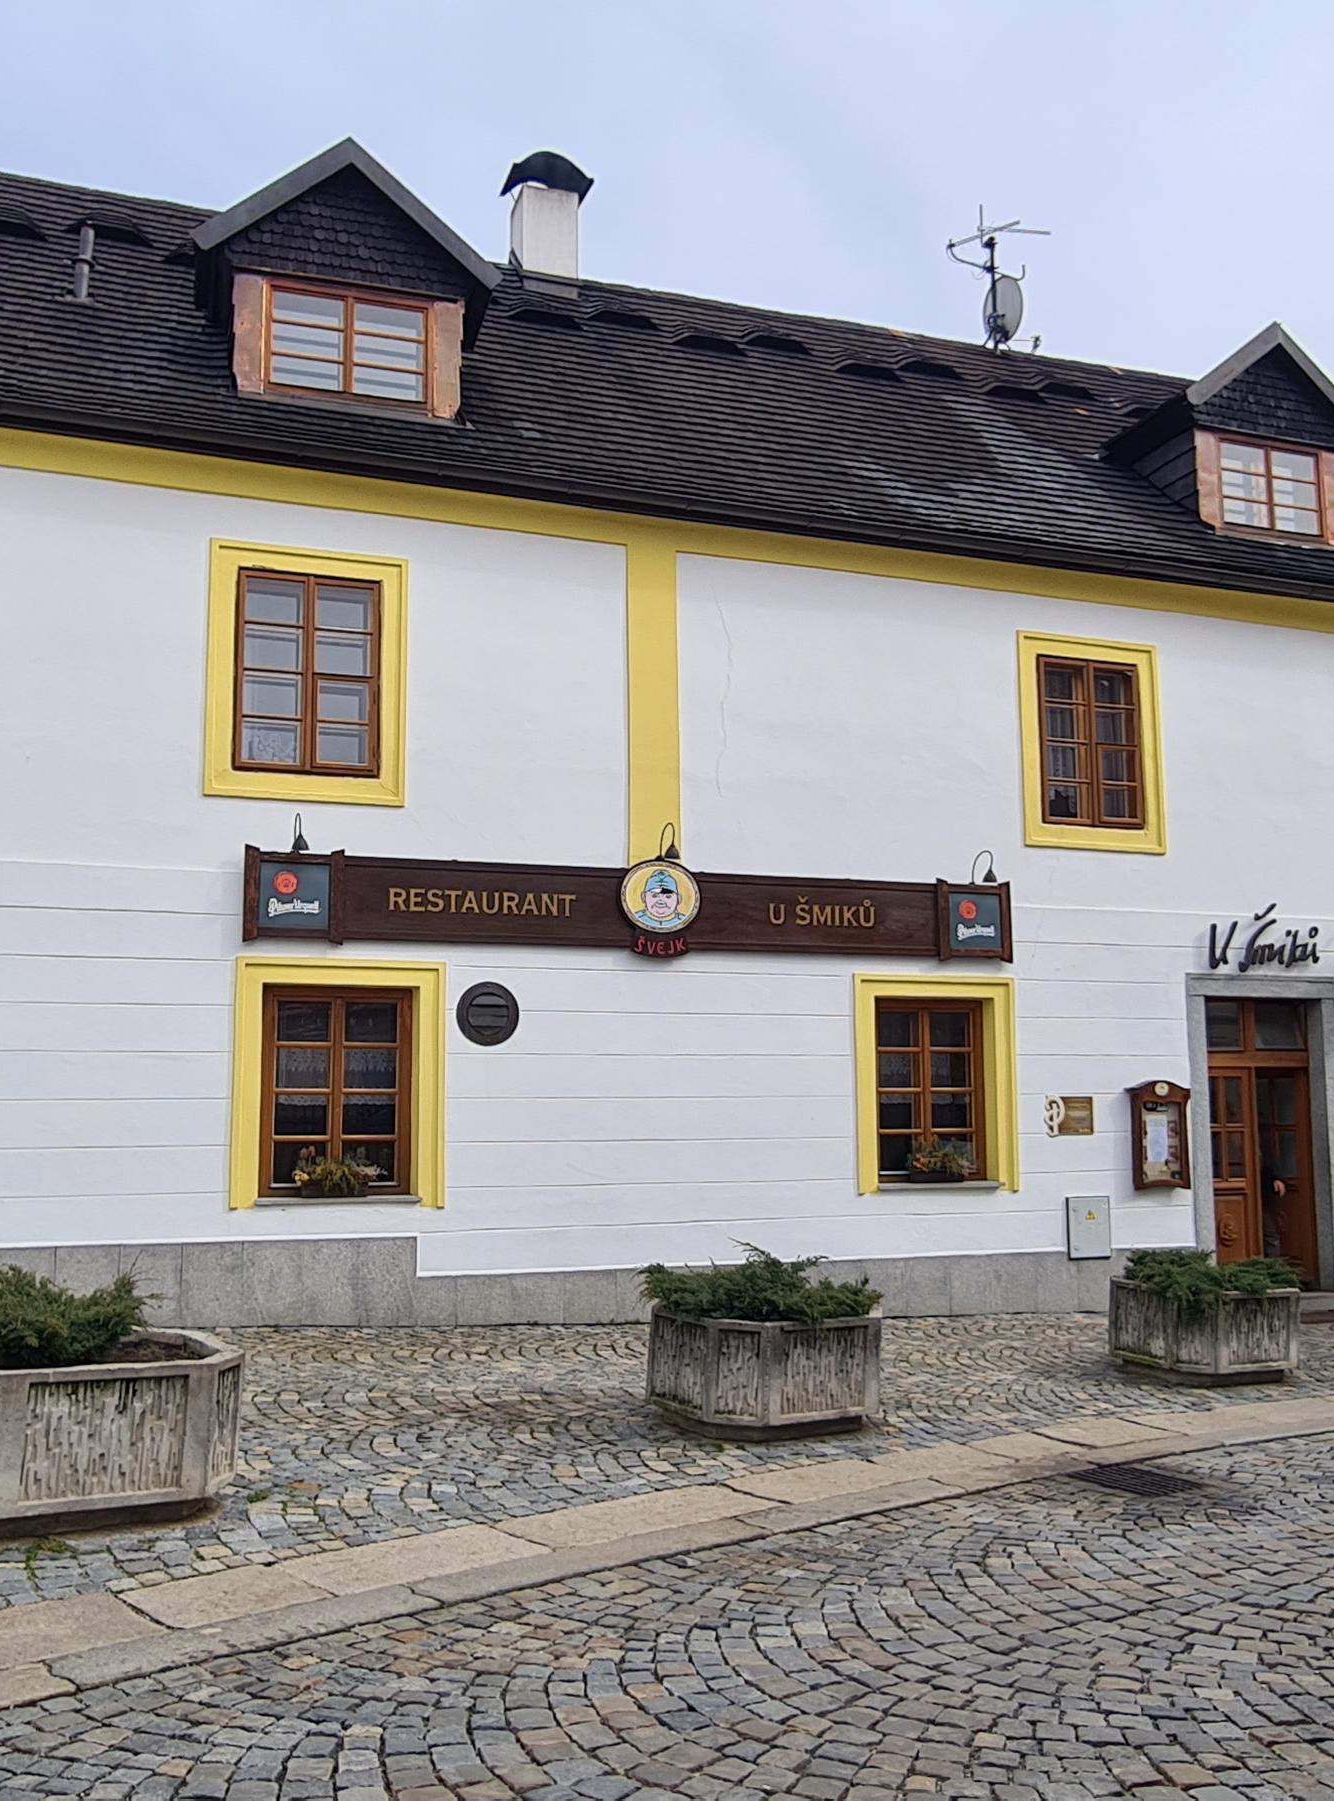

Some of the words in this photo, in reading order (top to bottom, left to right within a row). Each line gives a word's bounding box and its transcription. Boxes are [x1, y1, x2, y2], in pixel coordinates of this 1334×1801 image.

[387, 887, 577, 918] RESTAURANT
[769, 903, 786, 925] U
[795, 895, 876, 928] ŠMIKŮ
[634, 935, 686, 955] ŠVEJK
[1208, 920, 1238, 970] U
